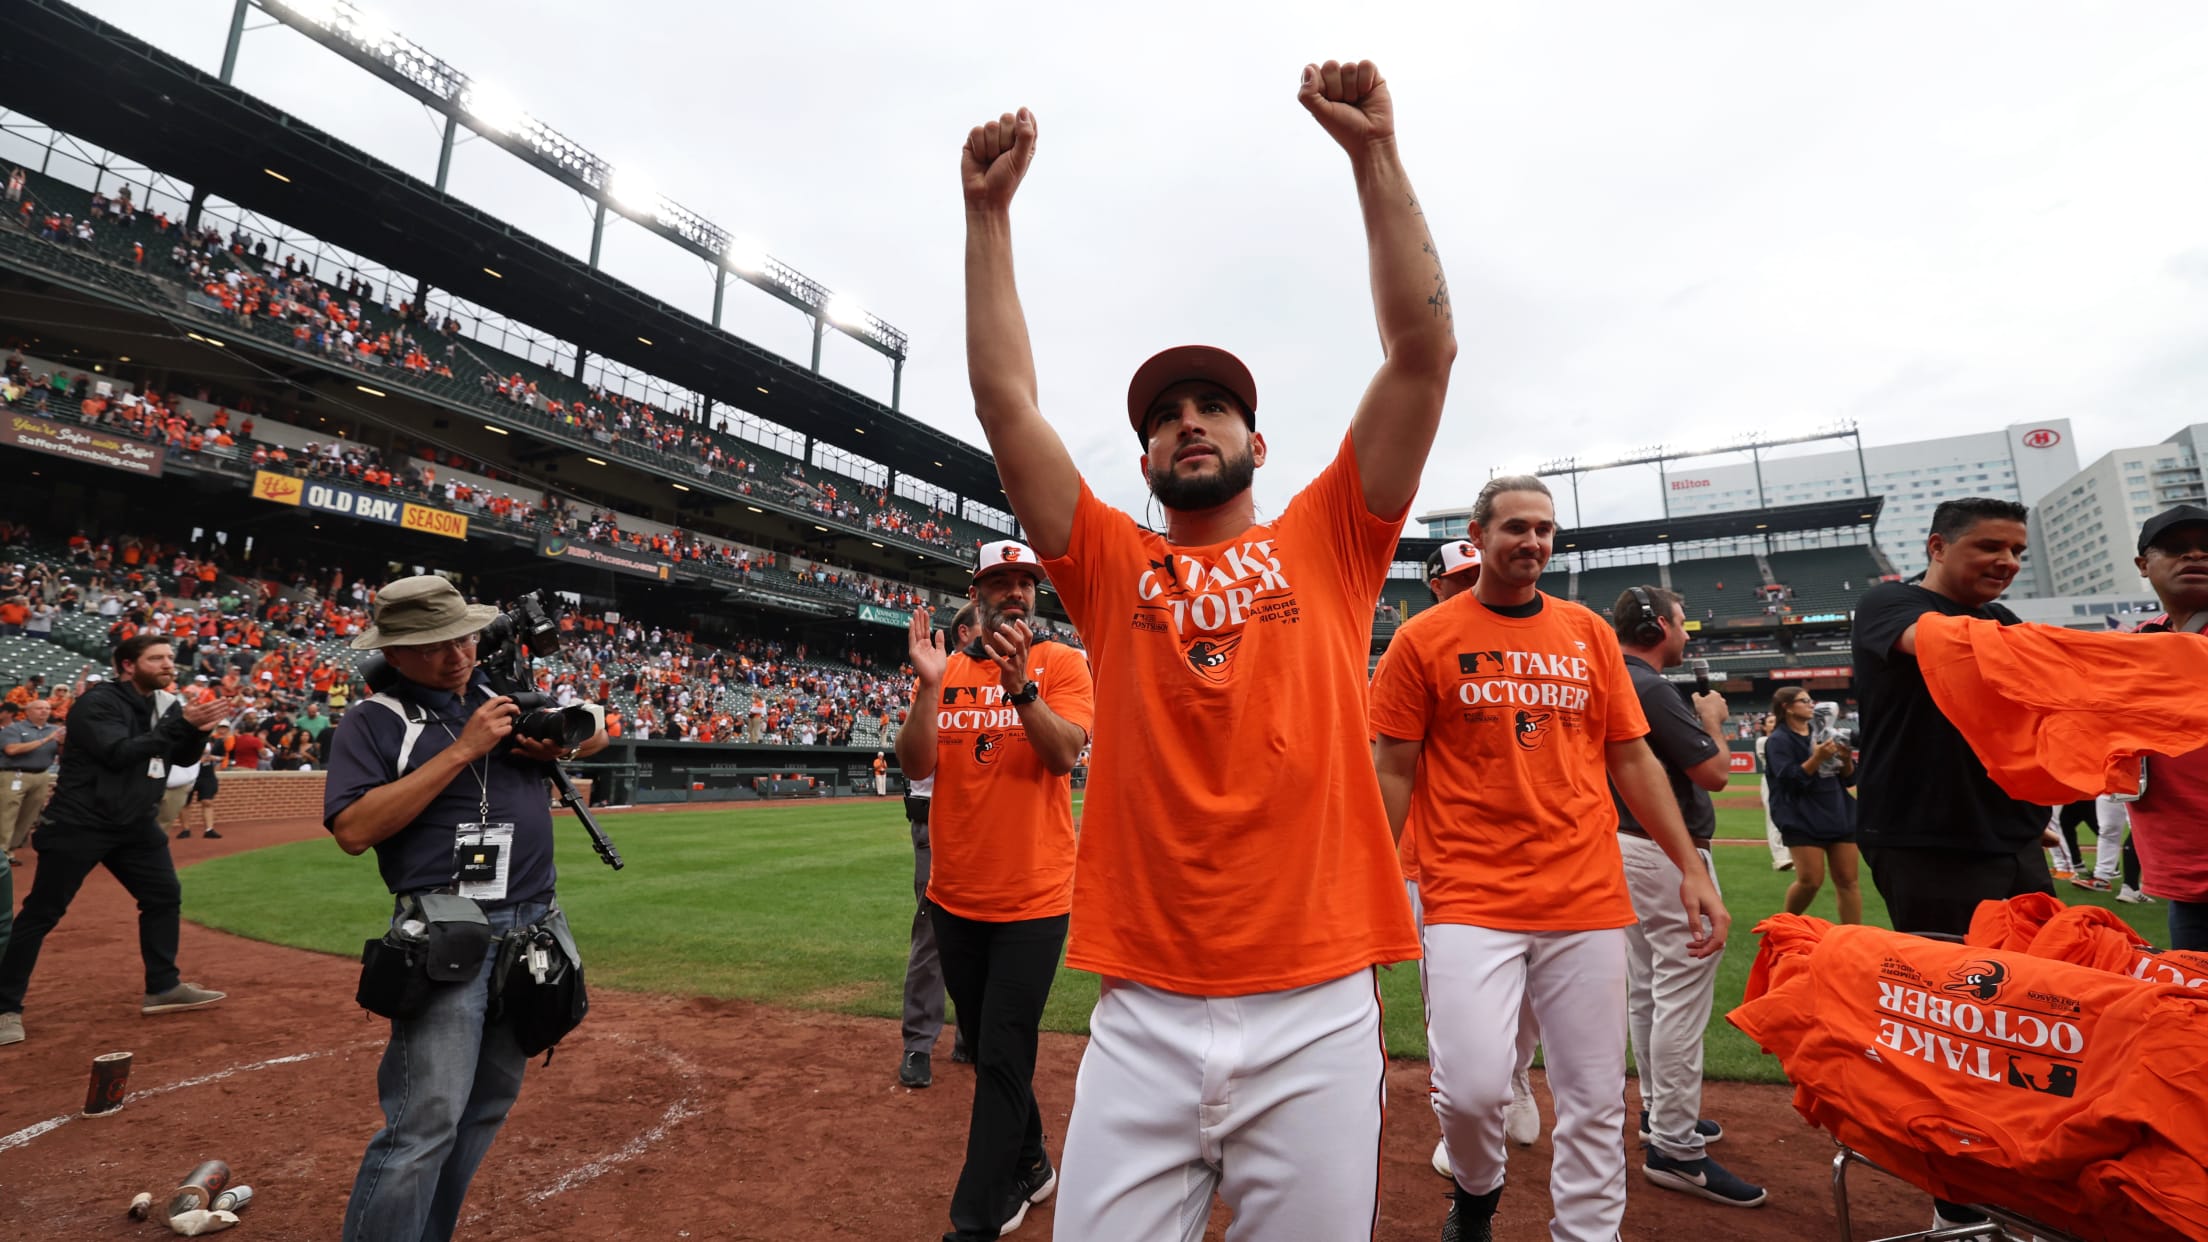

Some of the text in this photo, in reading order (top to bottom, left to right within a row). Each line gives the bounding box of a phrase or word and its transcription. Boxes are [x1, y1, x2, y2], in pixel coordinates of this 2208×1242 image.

[11, 417, 57, 436] You're
[17, 434, 150, 470] SafferPlumbing.com
[1671, 479, 1711, 490] Hilton
[262, 476, 463, 535] It's OLD BAY SEASON
[1138, 557, 1290, 635] OTOBR
[1249, 598, 1297, 617] ALTIMORE
[1259, 607, 1298, 624] RIOLES
[1506, 651, 1589, 681] TAKE
[1459, 680, 1589, 711] OCTOBER
[938, 708, 1024, 730] OCTOBE
[1876, 981, 2084, 1054] OCTOBER
[1875, 1018, 2001, 1083] TAKE
